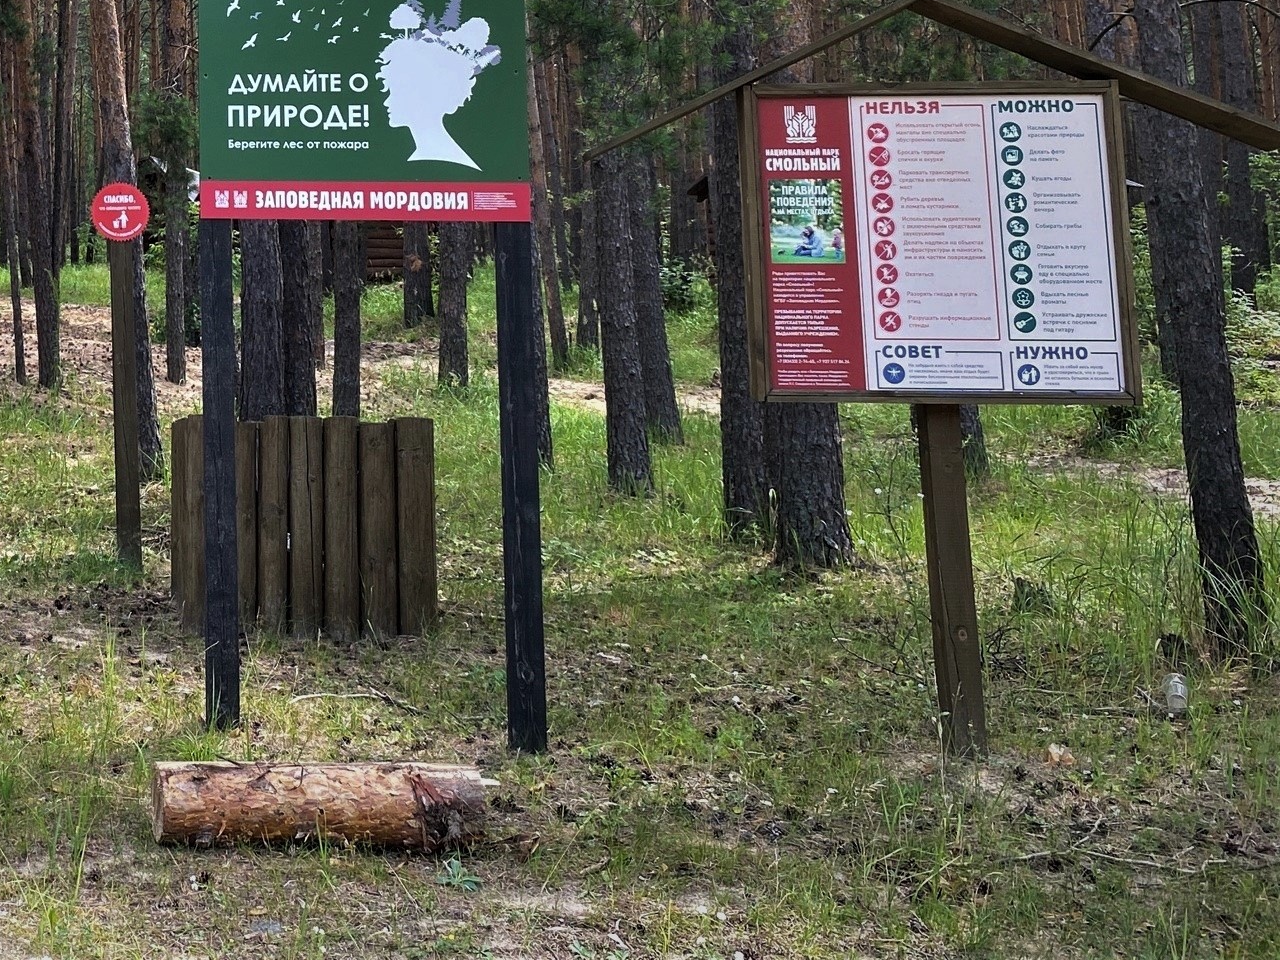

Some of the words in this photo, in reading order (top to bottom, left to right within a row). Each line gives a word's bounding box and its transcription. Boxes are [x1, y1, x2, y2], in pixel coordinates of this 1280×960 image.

[228, 69, 342, 95] ДУМАЙТЕ
[349, 73, 369, 93] О
[865, 101, 940, 114] НЕЛЬЗЯ
[998, 100, 1074, 113] МОЖНО
[227, 104, 370, 130] ПРИРОДЕ!
[228, 139, 280, 150] Берегите
[283, 141, 303, 149] лес
[306, 141, 321, 149] от
[323, 141, 369, 151] пожара
[765, 148, 820, 156] НАЦИОНАЛЬНЫЙ
[765, 154, 841, 171] СМОЛЬНЫЙ
[782, 186, 827, 195] ПРАВИЛА
[104, 194, 136, 204] СПАСИБО,
[255, 190, 365, 211] ЗАПОВЕДНАЯ
[370, 191, 468, 212] МОРДОВИЯ
[776, 197, 834, 208] ПОВЕДЕНИЯ
[882, 345, 942, 359] СОВЕТ
[1015, 346, 1088, 360] НУЖНО
